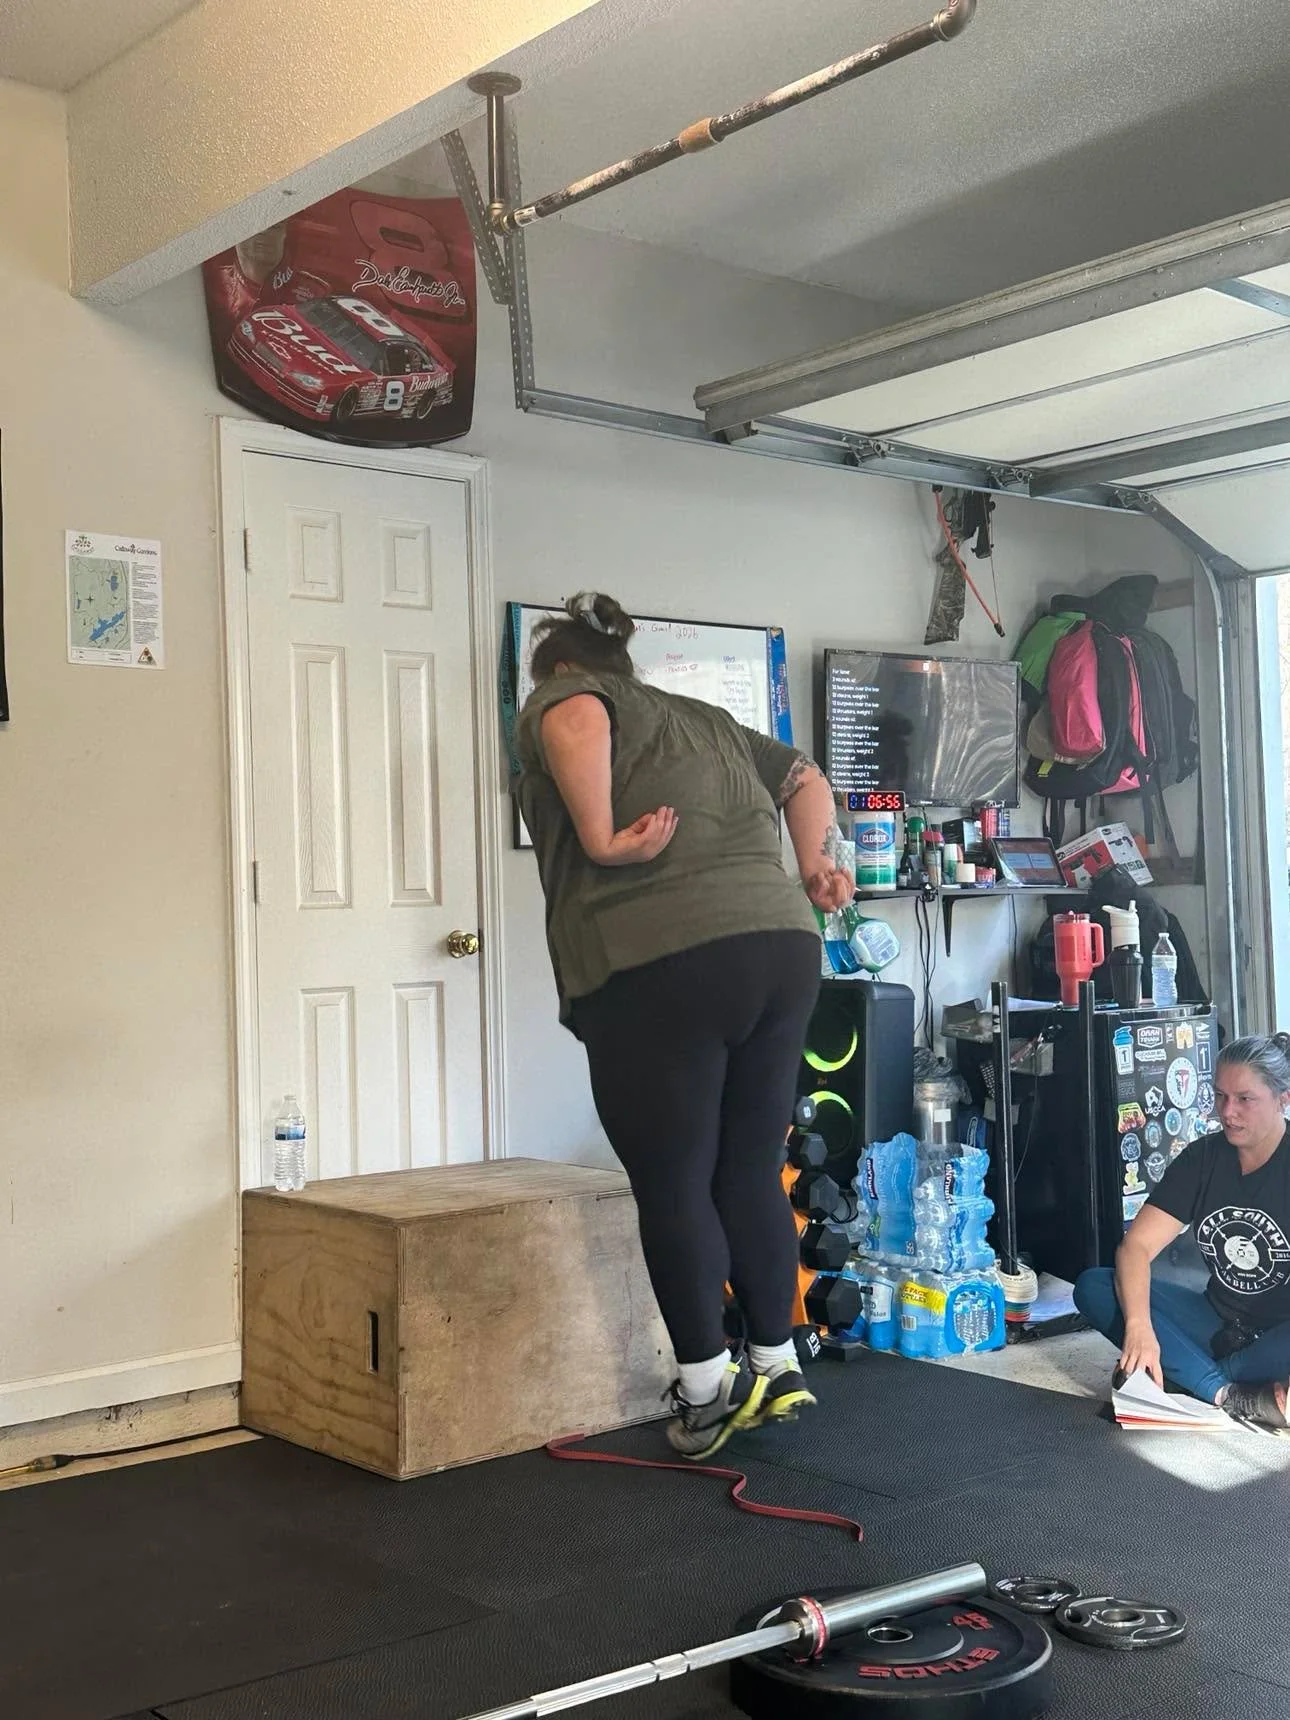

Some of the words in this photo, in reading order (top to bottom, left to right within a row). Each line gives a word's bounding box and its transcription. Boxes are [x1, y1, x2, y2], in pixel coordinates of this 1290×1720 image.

[251, 310, 362, 375] Bud
[383, 381, 405, 411] 8
[850, 794, 865, 808] 01
[868, 794, 900, 808] 06:56
[862, 834, 886, 842] CLOROX
[1144, 1105, 1166, 1114] USCCA
[866, 1158, 876, 1198] KIRKLAND
[944, 1163, 956, 1205] KIRKLAND
[1202, 1212, 1230, 1236] ALL
[1232, 1210, 1285, 1248] SOUTH
[857, 1647, 1000, 1679] ETHOS
